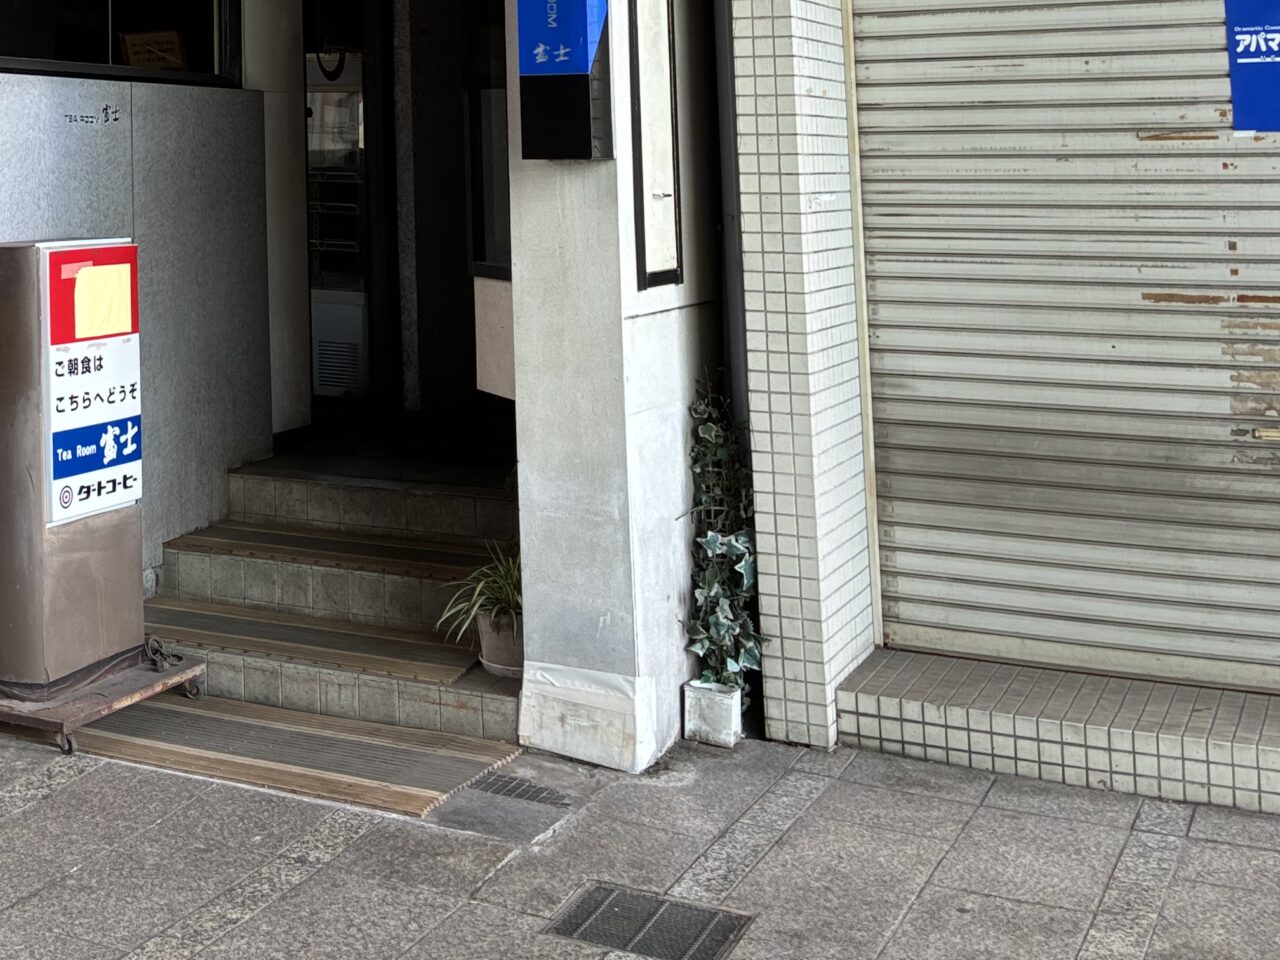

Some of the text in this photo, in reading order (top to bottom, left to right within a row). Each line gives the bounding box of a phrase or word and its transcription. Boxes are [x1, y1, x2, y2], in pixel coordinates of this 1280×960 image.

[55, 354, 104, 377] ご朝食は
[55, 381, 138, 414] こちらへどうぞ
[57, 444, 97, 461] Tea Room
[77, 473, 138, 502] ダートコーヒー
